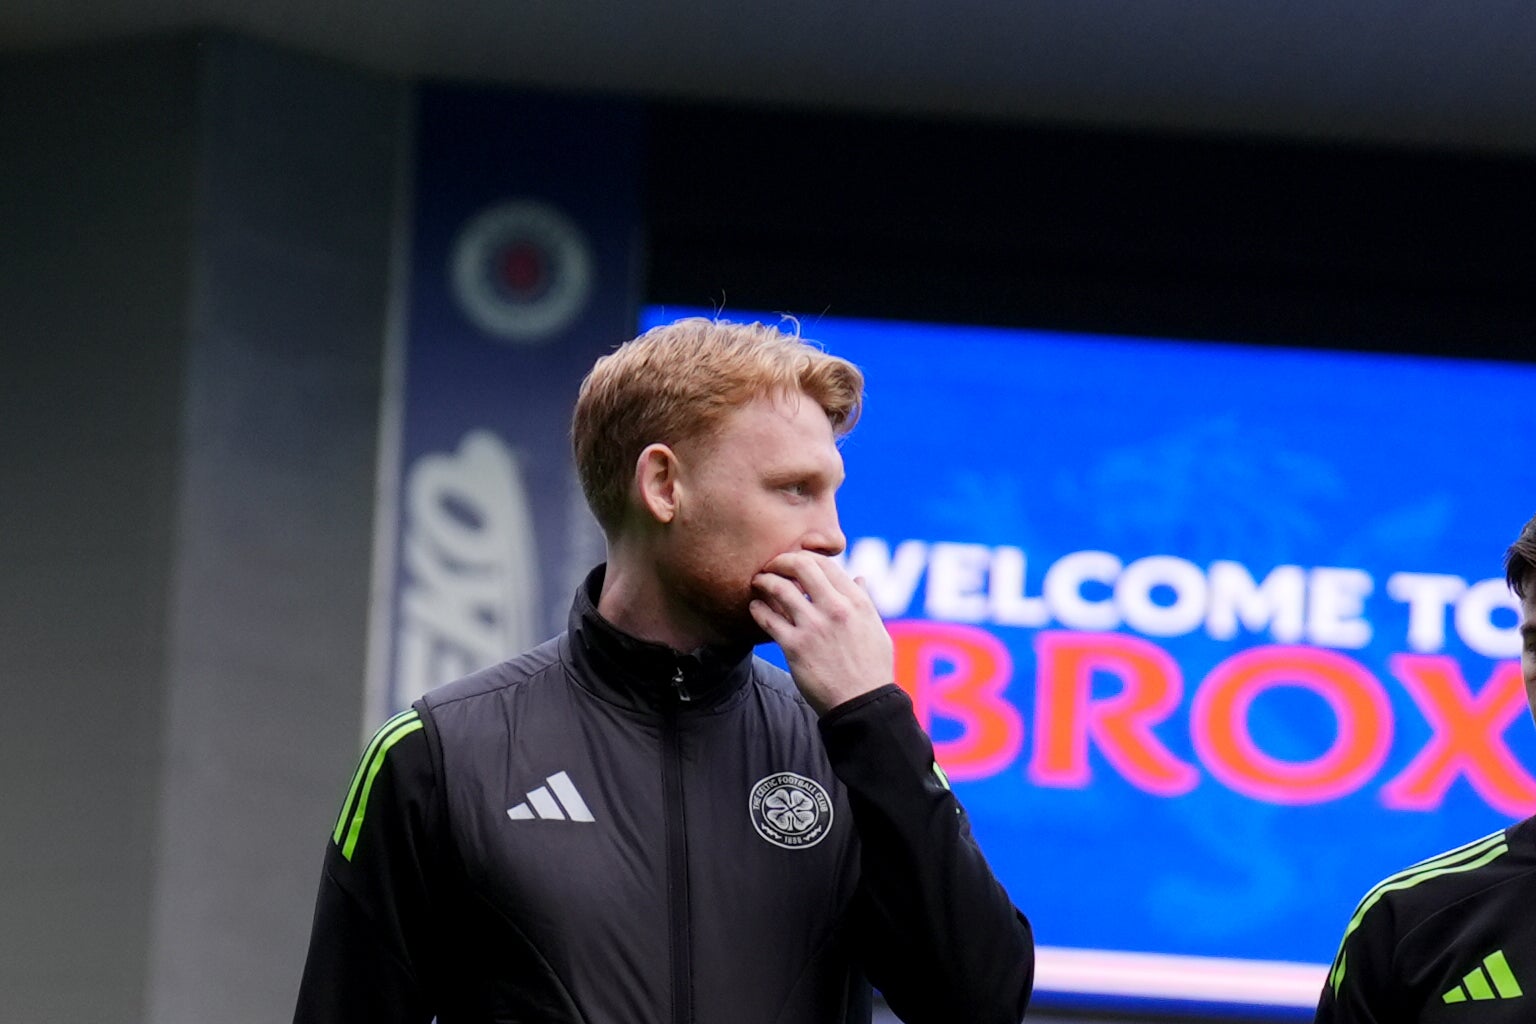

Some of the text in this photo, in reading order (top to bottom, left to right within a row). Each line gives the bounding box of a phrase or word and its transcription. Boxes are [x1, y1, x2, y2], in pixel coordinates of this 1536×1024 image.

[846, 537, 1523, 660] WELCOME TO
[756, 778, 778, 797] CELTIC
[777, 776, 817, 795] FOOTBALL
[814, 790, 828, 813] CLUB
